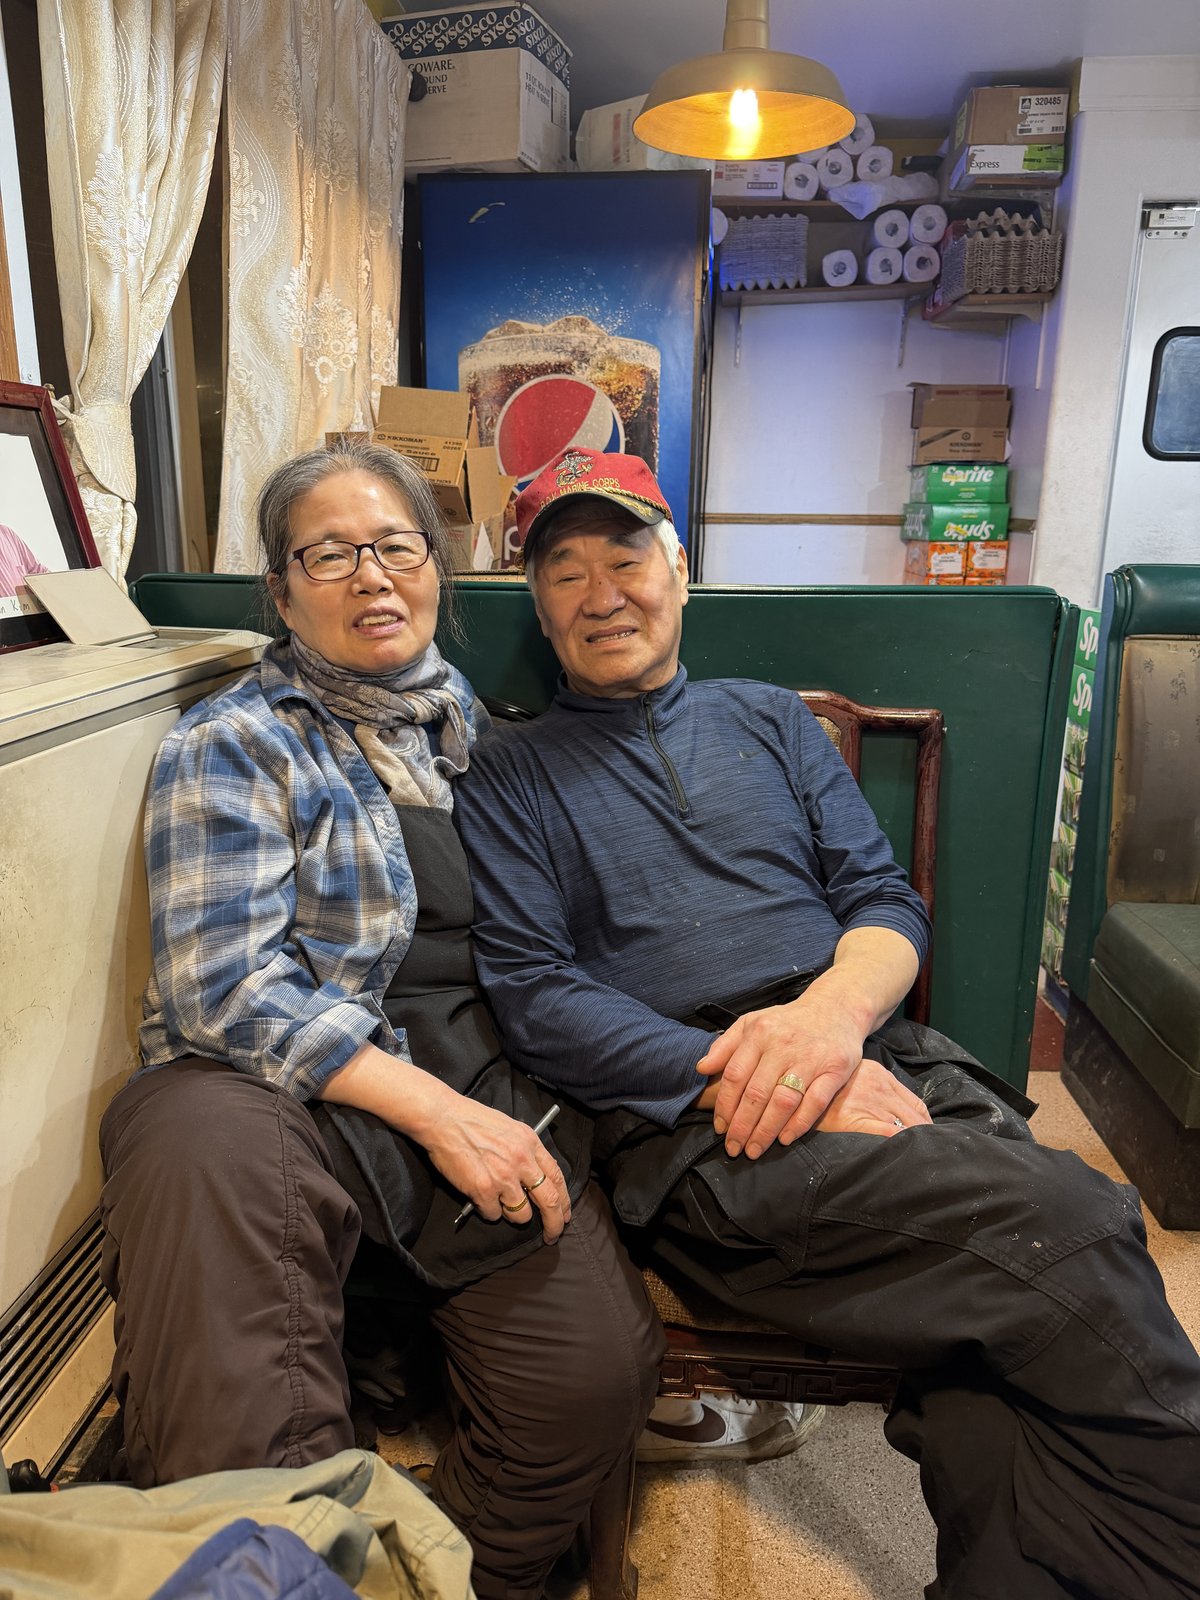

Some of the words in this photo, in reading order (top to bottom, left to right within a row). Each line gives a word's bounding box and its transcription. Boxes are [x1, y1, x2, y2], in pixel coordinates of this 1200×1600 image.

[412, 17, 449, 55] SYSCO
[434, 14, 473, 52] SYSCO
[457, 11, 497, 49] SYSCO
[480, 8, 521, 47] SYSCO
[505, 16, 535, 45] SYSCO
[428, 84, 447, 95] ERVE
[970, 160, 1000, 170] Express
[387, 435, 423, 443] KIKKOMAN
[592, 477, 621, 488] CORPS
[942, 466, 994, 486] Sprite
[10, 599, 30, 612] Km
